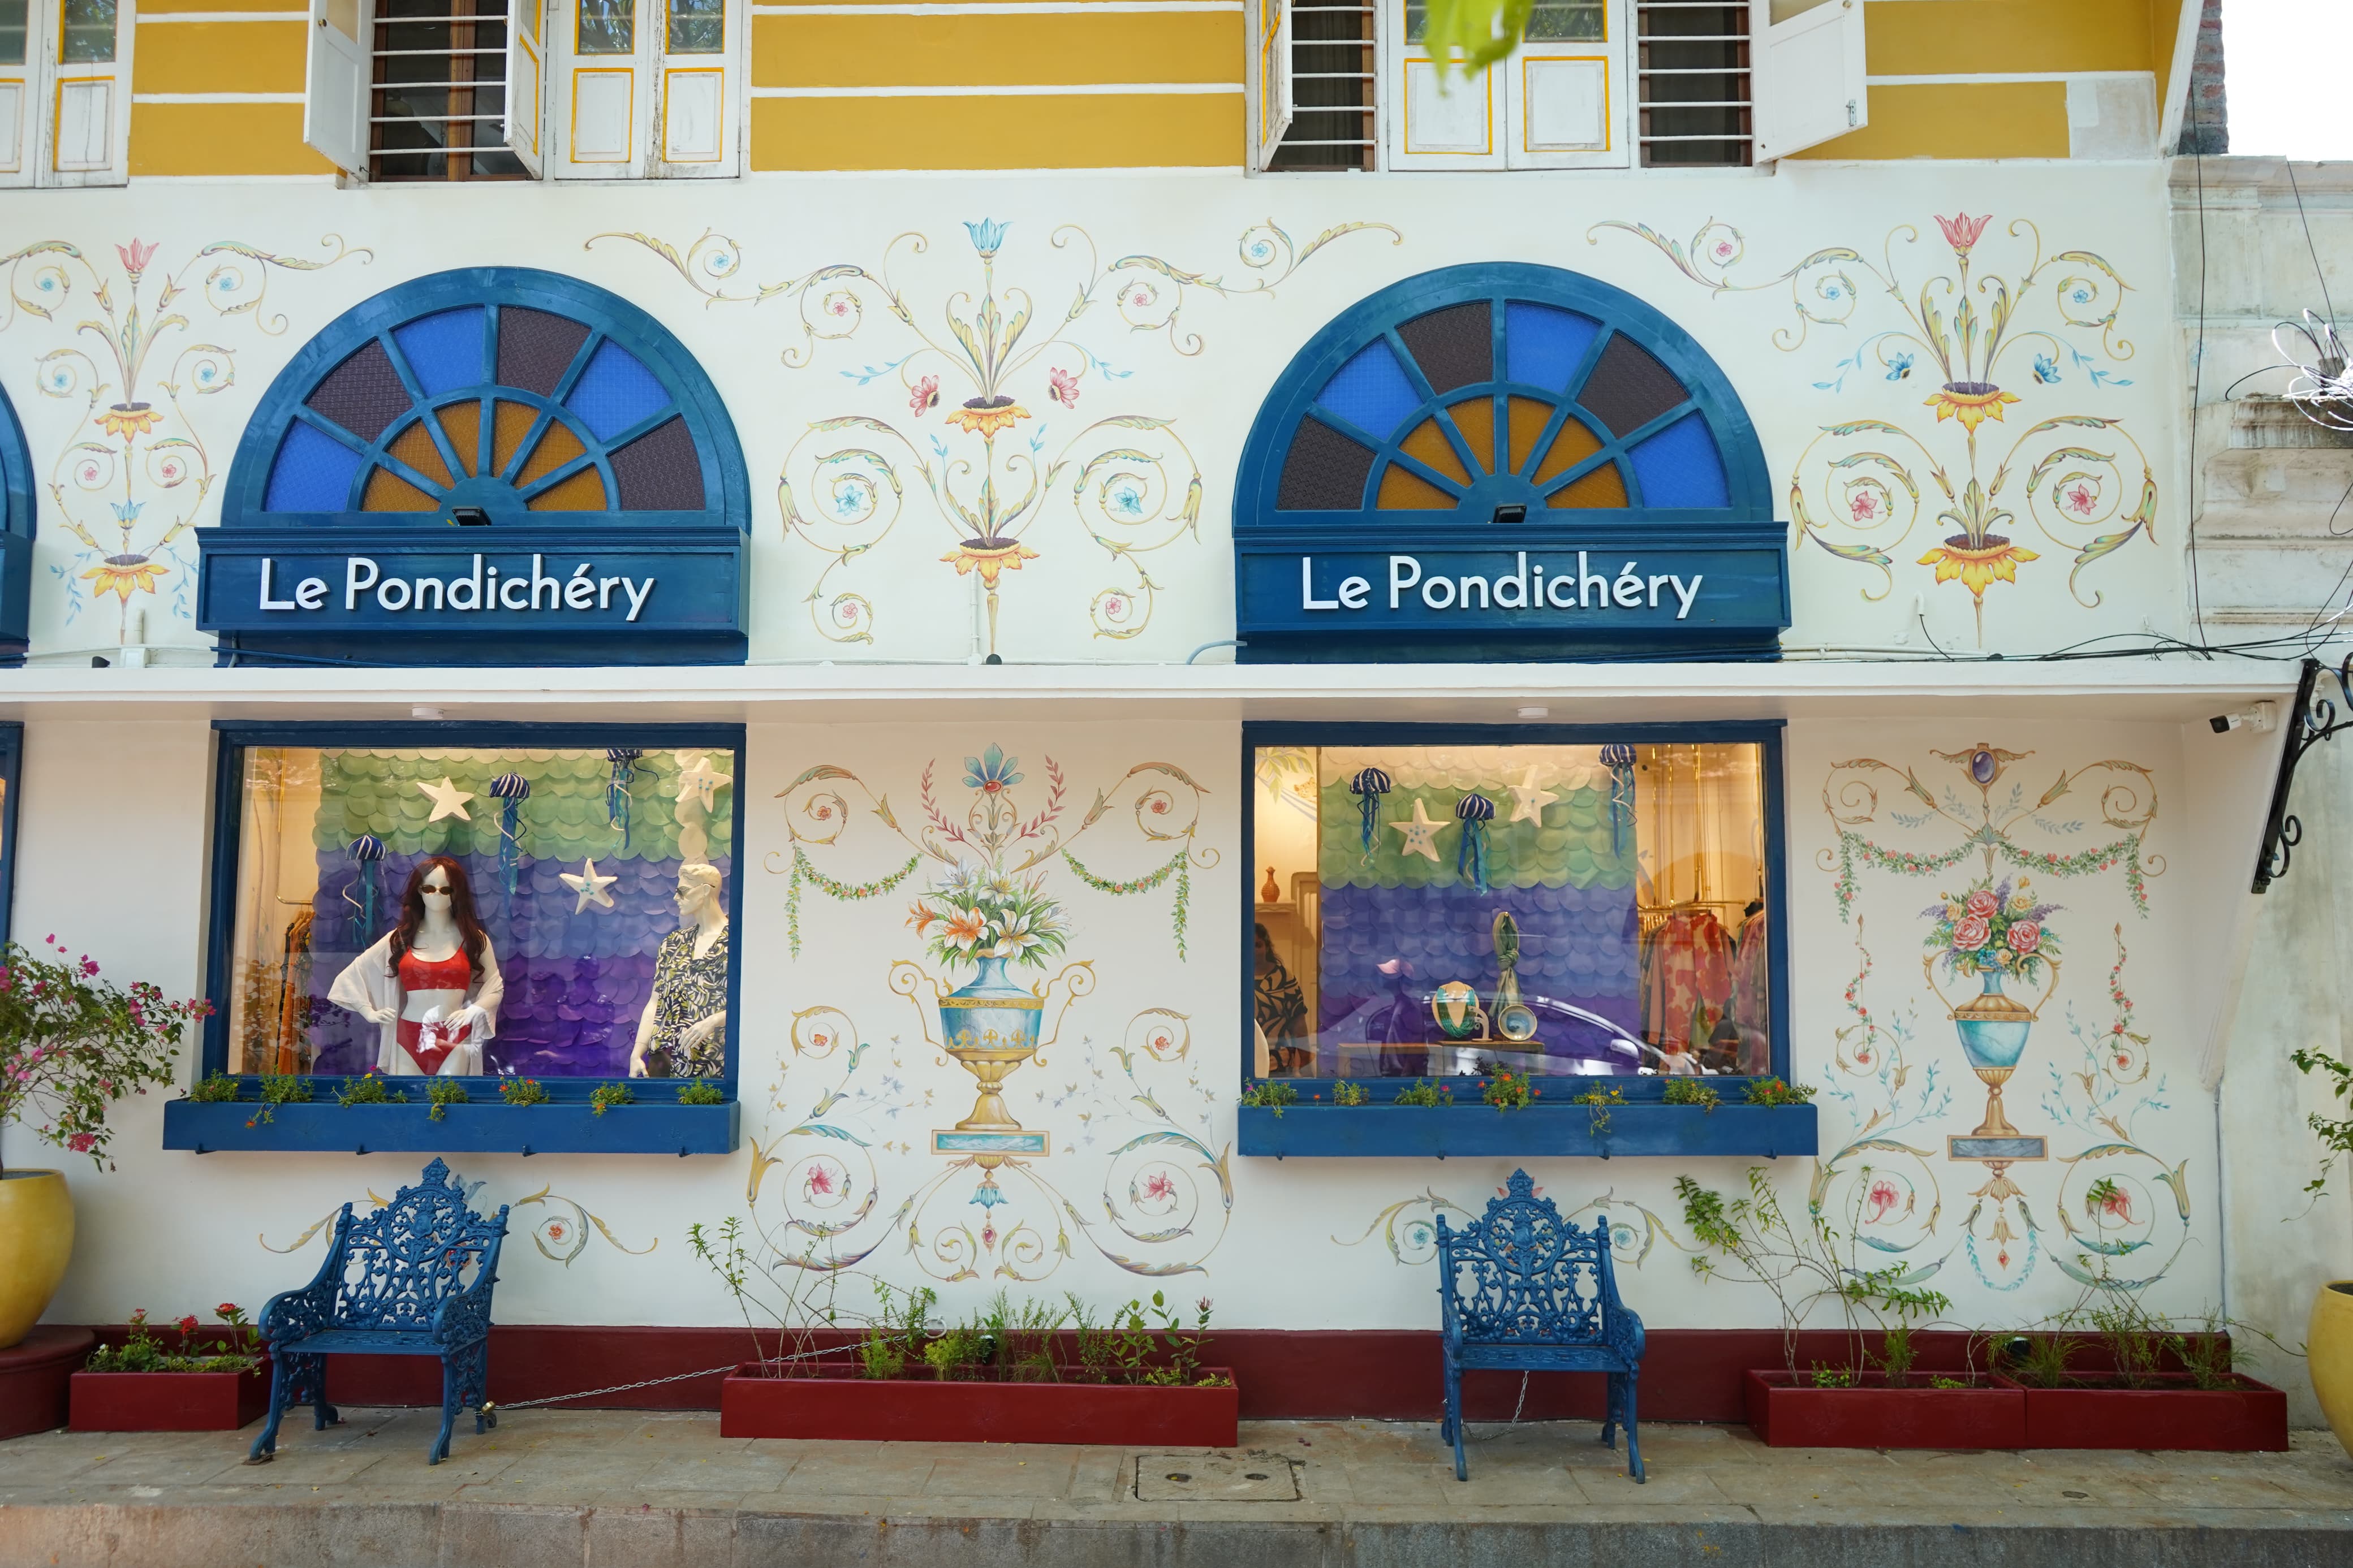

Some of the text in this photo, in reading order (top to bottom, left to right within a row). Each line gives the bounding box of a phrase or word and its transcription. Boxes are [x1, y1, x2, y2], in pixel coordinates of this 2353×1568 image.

[260, 554, 654, 621] Le Pondichéry
[1303, 551, 1703, 619] Le Pondichéry
